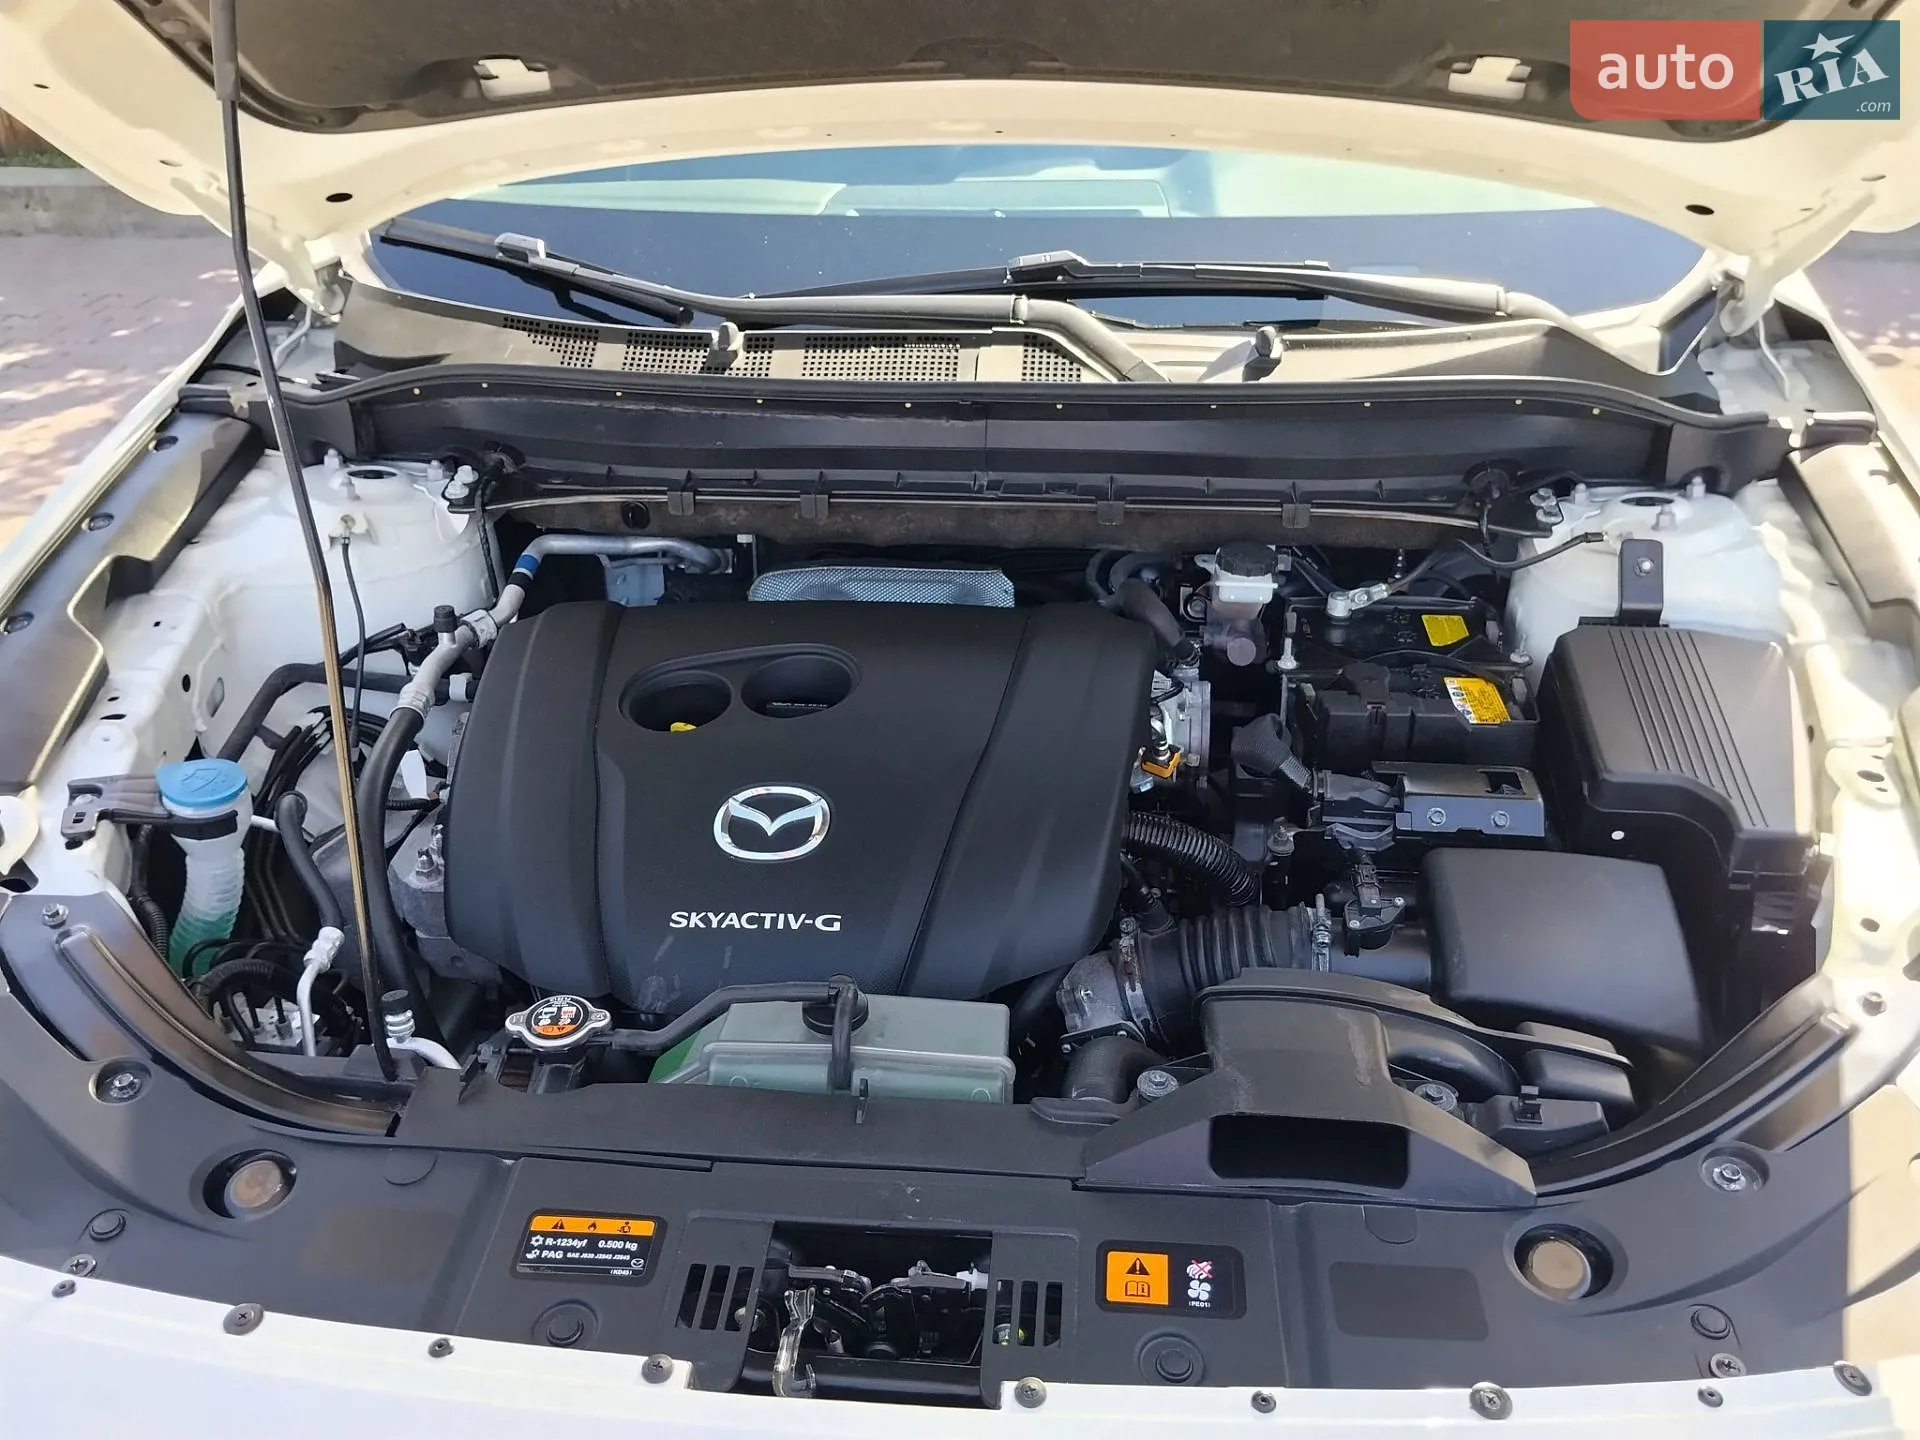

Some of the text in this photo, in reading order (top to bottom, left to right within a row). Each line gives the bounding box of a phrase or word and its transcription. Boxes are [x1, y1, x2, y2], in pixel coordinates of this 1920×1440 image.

[669, 911, 842, 932] SKYACTIV-G
[545, 1237, 638, 1251] R-1234yf 0.500 kg
[541, 1250, 564, 1259] PAG
